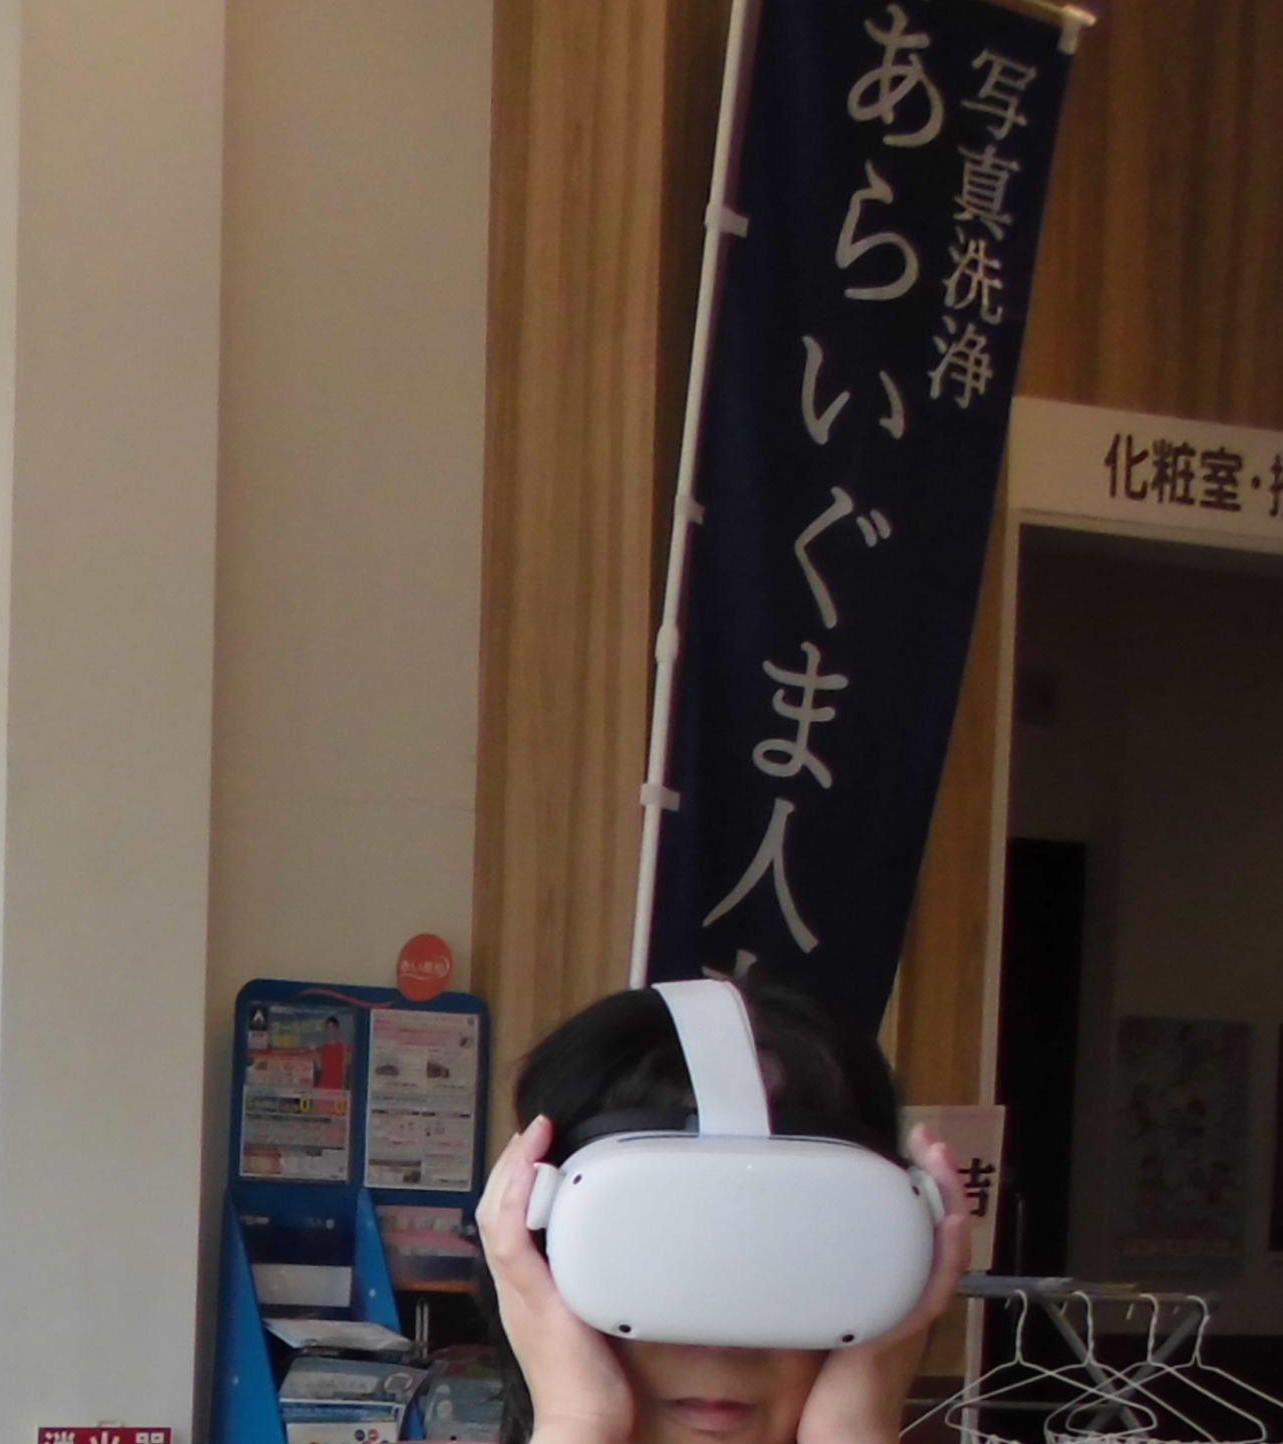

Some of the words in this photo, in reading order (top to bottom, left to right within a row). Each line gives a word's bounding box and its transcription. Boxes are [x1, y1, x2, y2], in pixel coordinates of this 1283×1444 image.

[702, 3, 946, 980] あらいぐま人
[927, 48, 1039, 410] 写真洗浄
